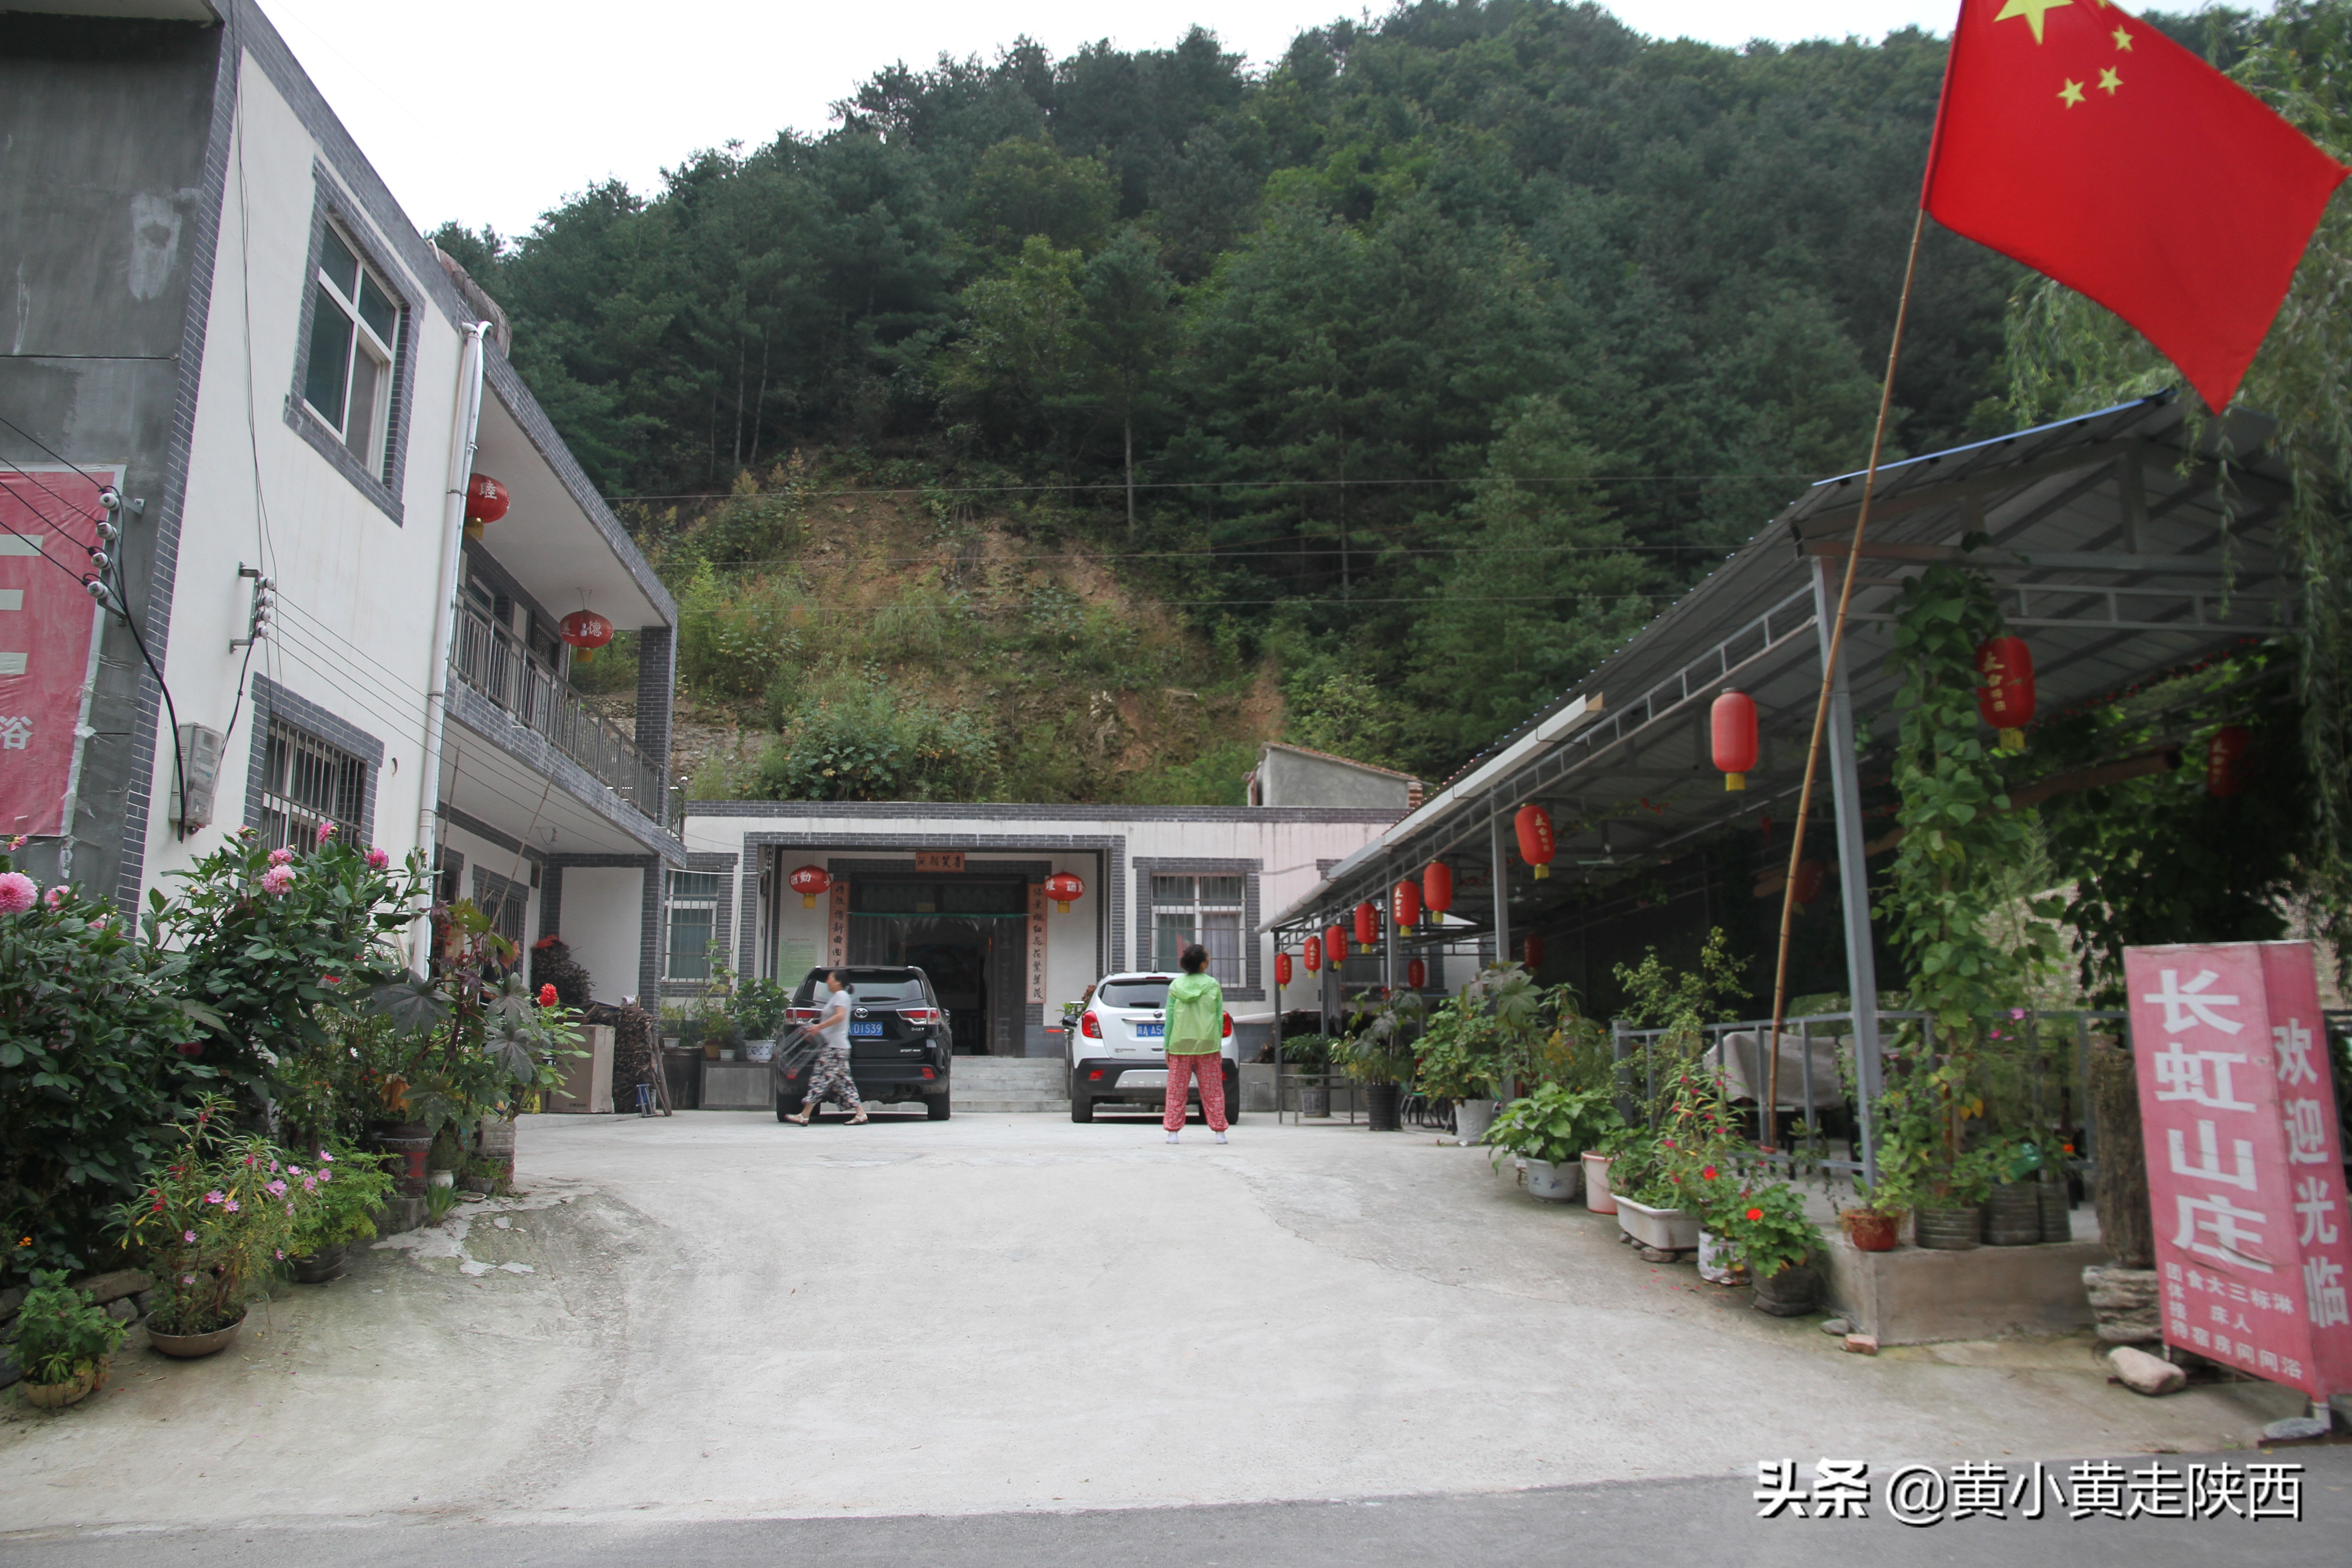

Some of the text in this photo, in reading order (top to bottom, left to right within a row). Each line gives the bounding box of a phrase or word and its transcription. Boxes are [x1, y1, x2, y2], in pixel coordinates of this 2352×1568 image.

[2144, 969, 2273, 1274] 长虹山庄
[2272, 1018, 2350, 1328] 欢迎光临
